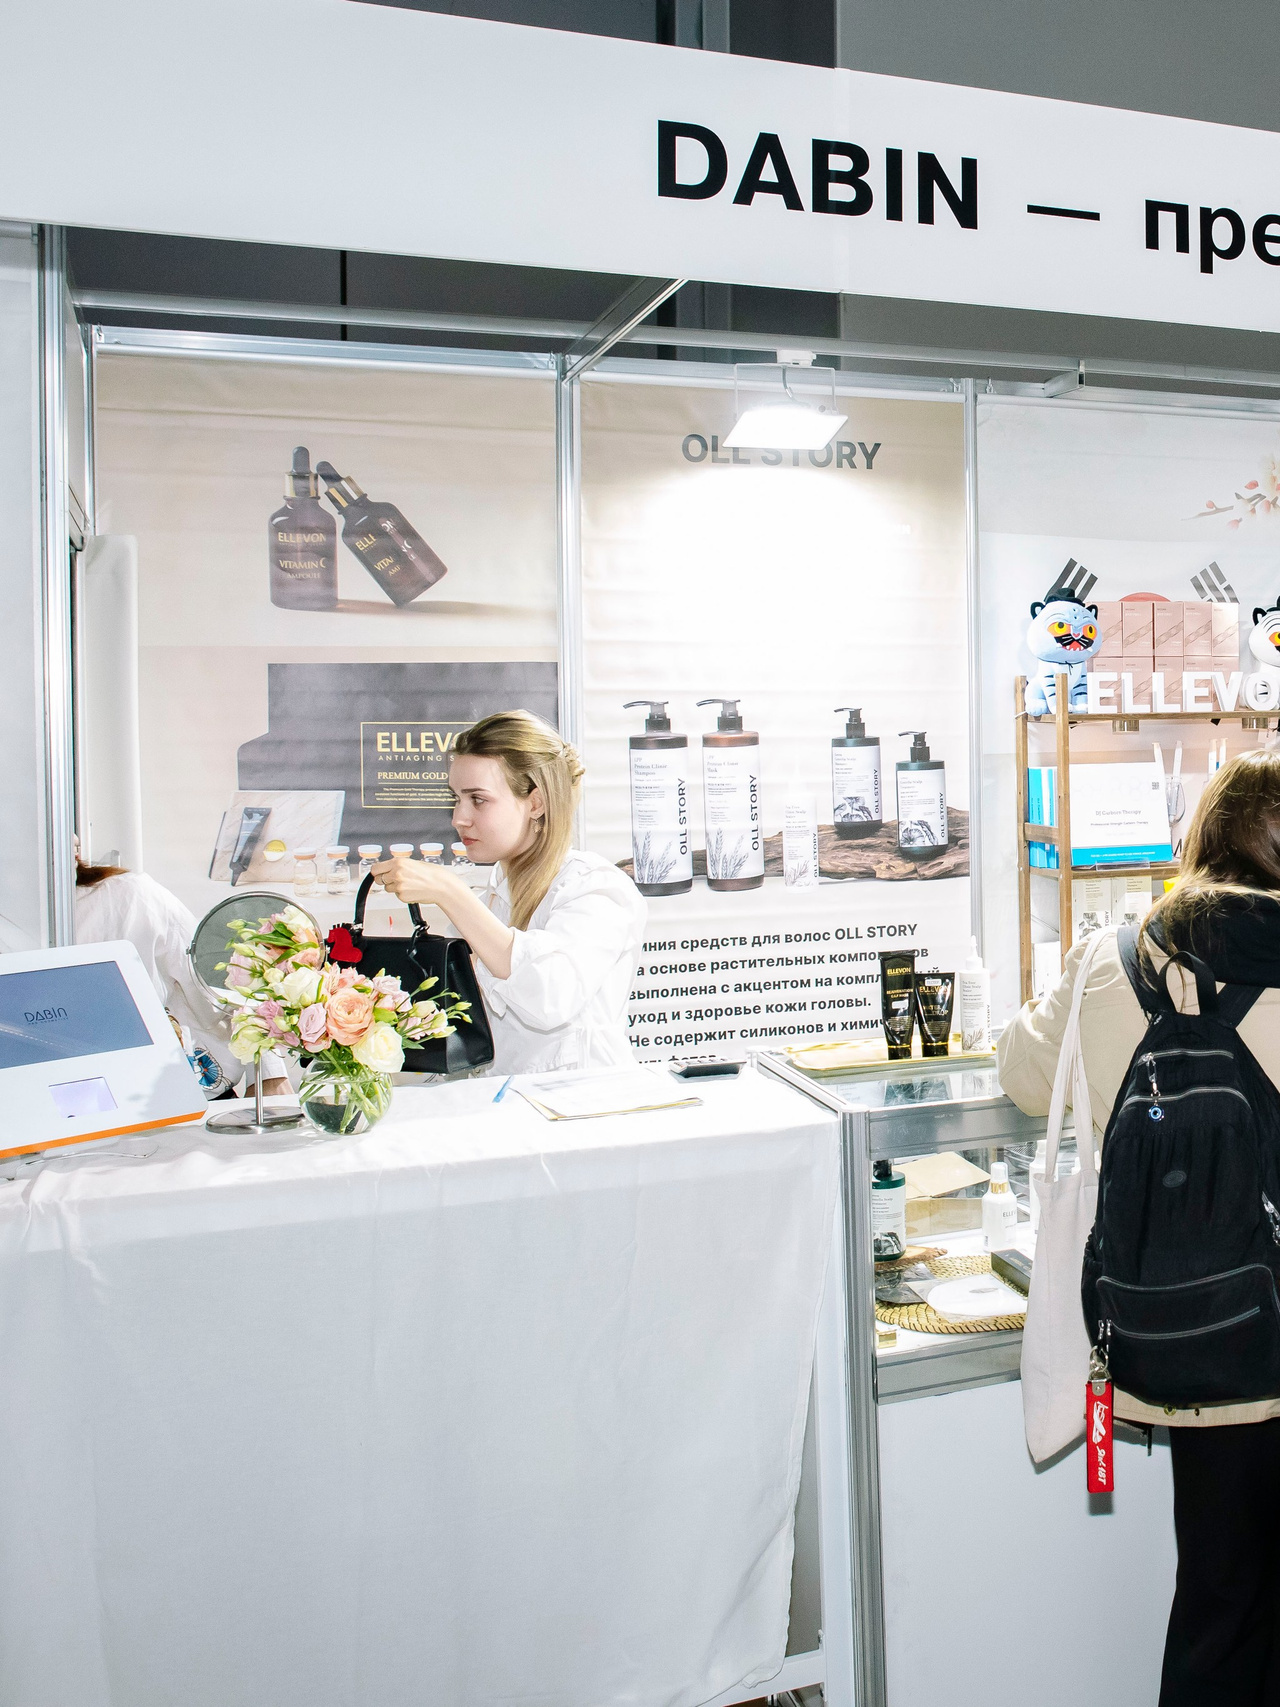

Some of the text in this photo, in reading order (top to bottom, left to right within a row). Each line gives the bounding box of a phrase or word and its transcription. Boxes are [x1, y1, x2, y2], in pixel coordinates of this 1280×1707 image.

[656, 119, 980, 231] DABIN
[278, 531, 327, 544] ELLEVON
[278, 558, 319, 570] VITAMIN
[377, 732, 462, 752] ELLEV
[378, 754, 443, 762] ANTIAGING
[377, 771, 449, 780] PREMIUM GOLD
[677, 778, 688, 855] OLL STORY
[749, 775, 759, 851] OLL STORY
[642, 923, 918, 952] иния средств для волос OLL STORY
[649, 962, 707, 975] основе
[710, 951, 825, 974] растительных
[886, 967, 911, 975] ELLEVON
[629, 984, 717, 1000] выполнена
[720, 983, 730, 993] с
[733, 977, 811, 994] акцентом
[815, 976, 833, 987] на
[24, 1007, 68, 1022] DABIN
[628, 997, 872, 1028] уход и здоровье кожи головы.
[629, 1033, 650, 1047] Не
[654, 1029, 736, 1046] содержит
[739, 1022, 824, 1039] силиконов
[827, 1021, 837, 1032] и
